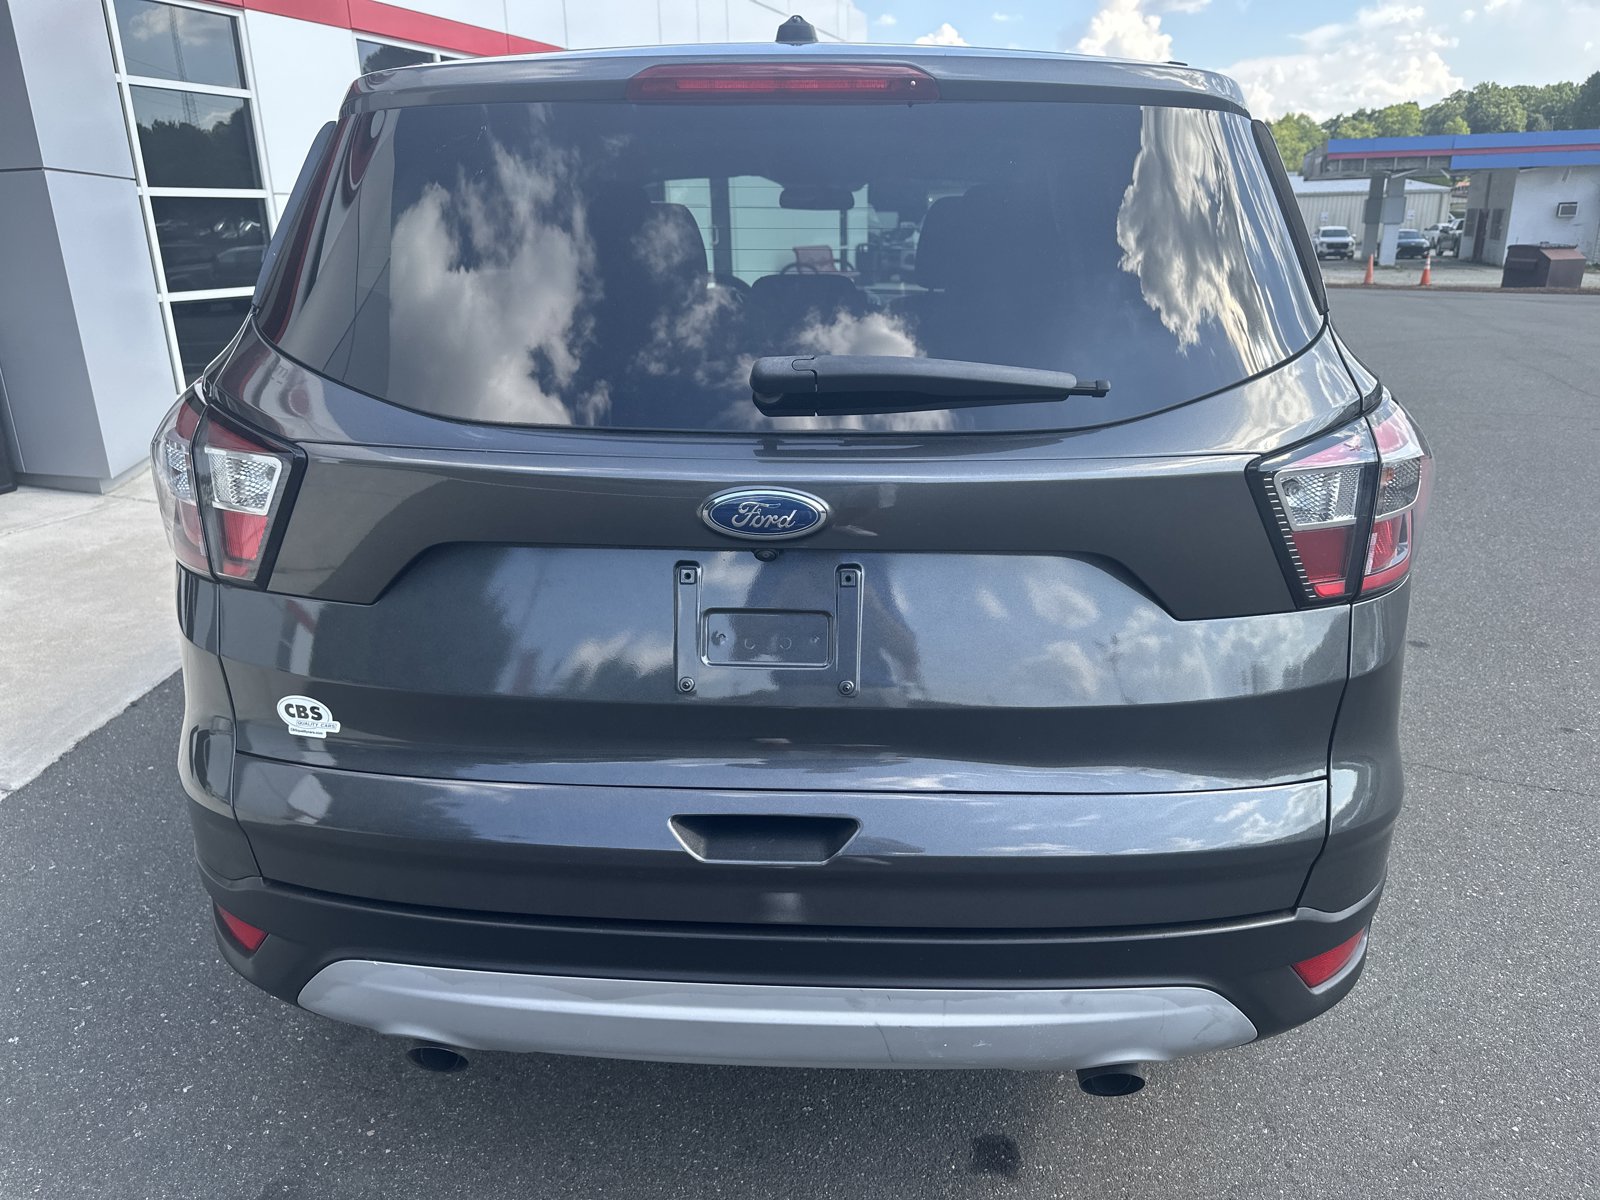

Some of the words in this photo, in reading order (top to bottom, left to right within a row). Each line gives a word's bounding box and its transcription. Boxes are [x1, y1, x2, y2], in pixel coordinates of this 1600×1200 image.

[731, 501, 798, 528] Ford
[284, 703, 323, 721] CBS
[297, 720, 318, 728] QUALITY
